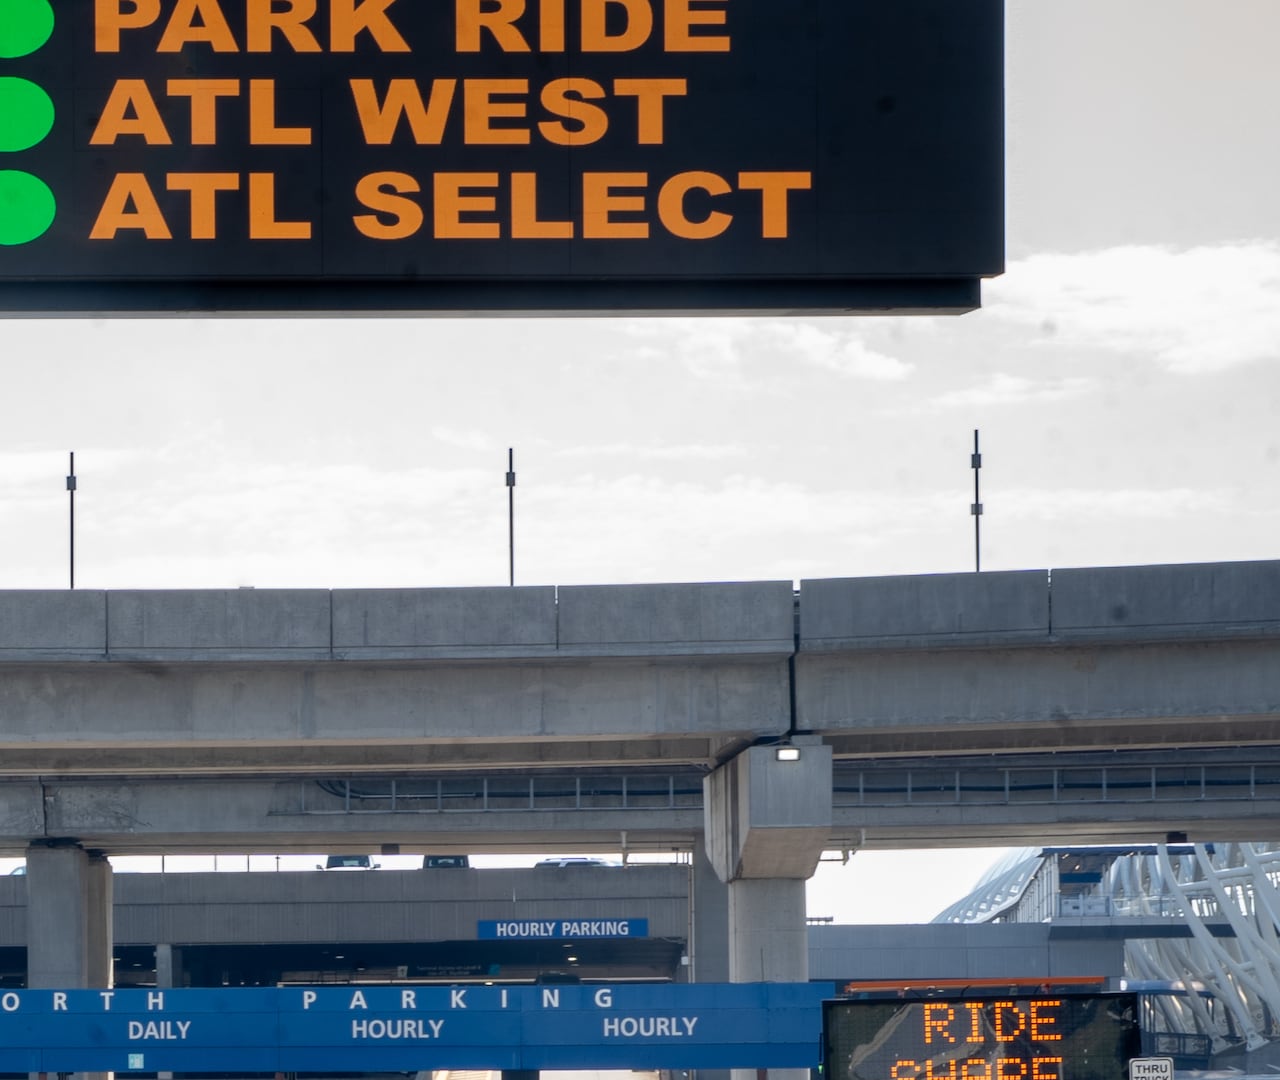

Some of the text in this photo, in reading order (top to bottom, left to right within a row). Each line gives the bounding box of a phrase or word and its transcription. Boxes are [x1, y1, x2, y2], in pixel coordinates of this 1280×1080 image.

[95, 0, 730, 52] PARK RIDE
[89, 78, 687, 146] ATL WEST
[89, 171, 811, 240] ATL SELECT
[496, 921, 629, 937] HOURLY PARKING
[303, 988, 612, 1010] PARKING
[128, 1021, 191, 1040] DAILY
[352, 1019, 444, 1039] HOURLY
[603, 1017, 698, 1037] HOURLY
[923, 1000, 1062, 1044] RIDE
[1135, 1064, 1168, 1073] THRU
